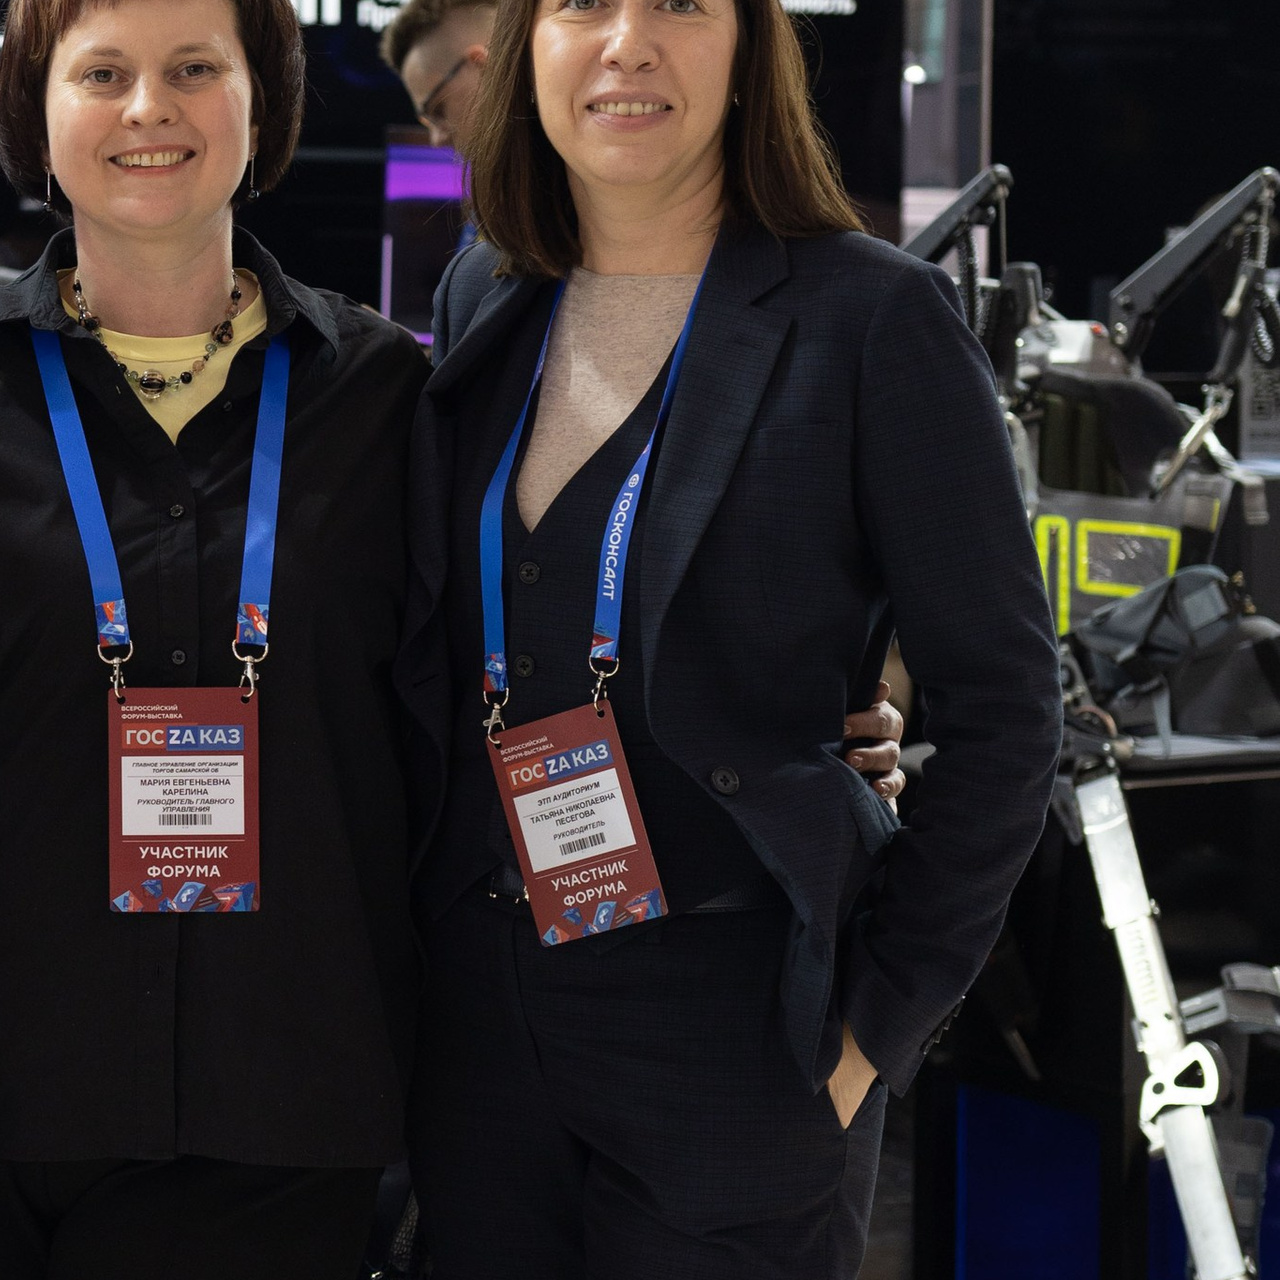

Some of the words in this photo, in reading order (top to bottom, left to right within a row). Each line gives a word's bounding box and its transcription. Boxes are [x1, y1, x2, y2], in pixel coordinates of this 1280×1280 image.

[603, 492, 633, 600] ГОСКОНСАЛТ
[162, 788, 209, 796] КАРЕЛИНА
[538, 796, 552, 807] ЭТП
[553, 781, 601, 802] АУДИТОРИУМ
[530, 808, 565, 825] ТАТЬЯНА
[565, 792, 616, 813] НИКОЛАЕВНА
[555, 809, 596, 827] ПЕСЕГОВА
[553, 820, 606, 841] РУКОВОДИТЕЛЬ
[139, 846, 229, 859] УЧАСТНИК
[147, 865, 221, 878] ФОРУМА
[551, 859, 629, 891] УЧАСТНИК
[563, 880, 628, 906] ФОРУМА
